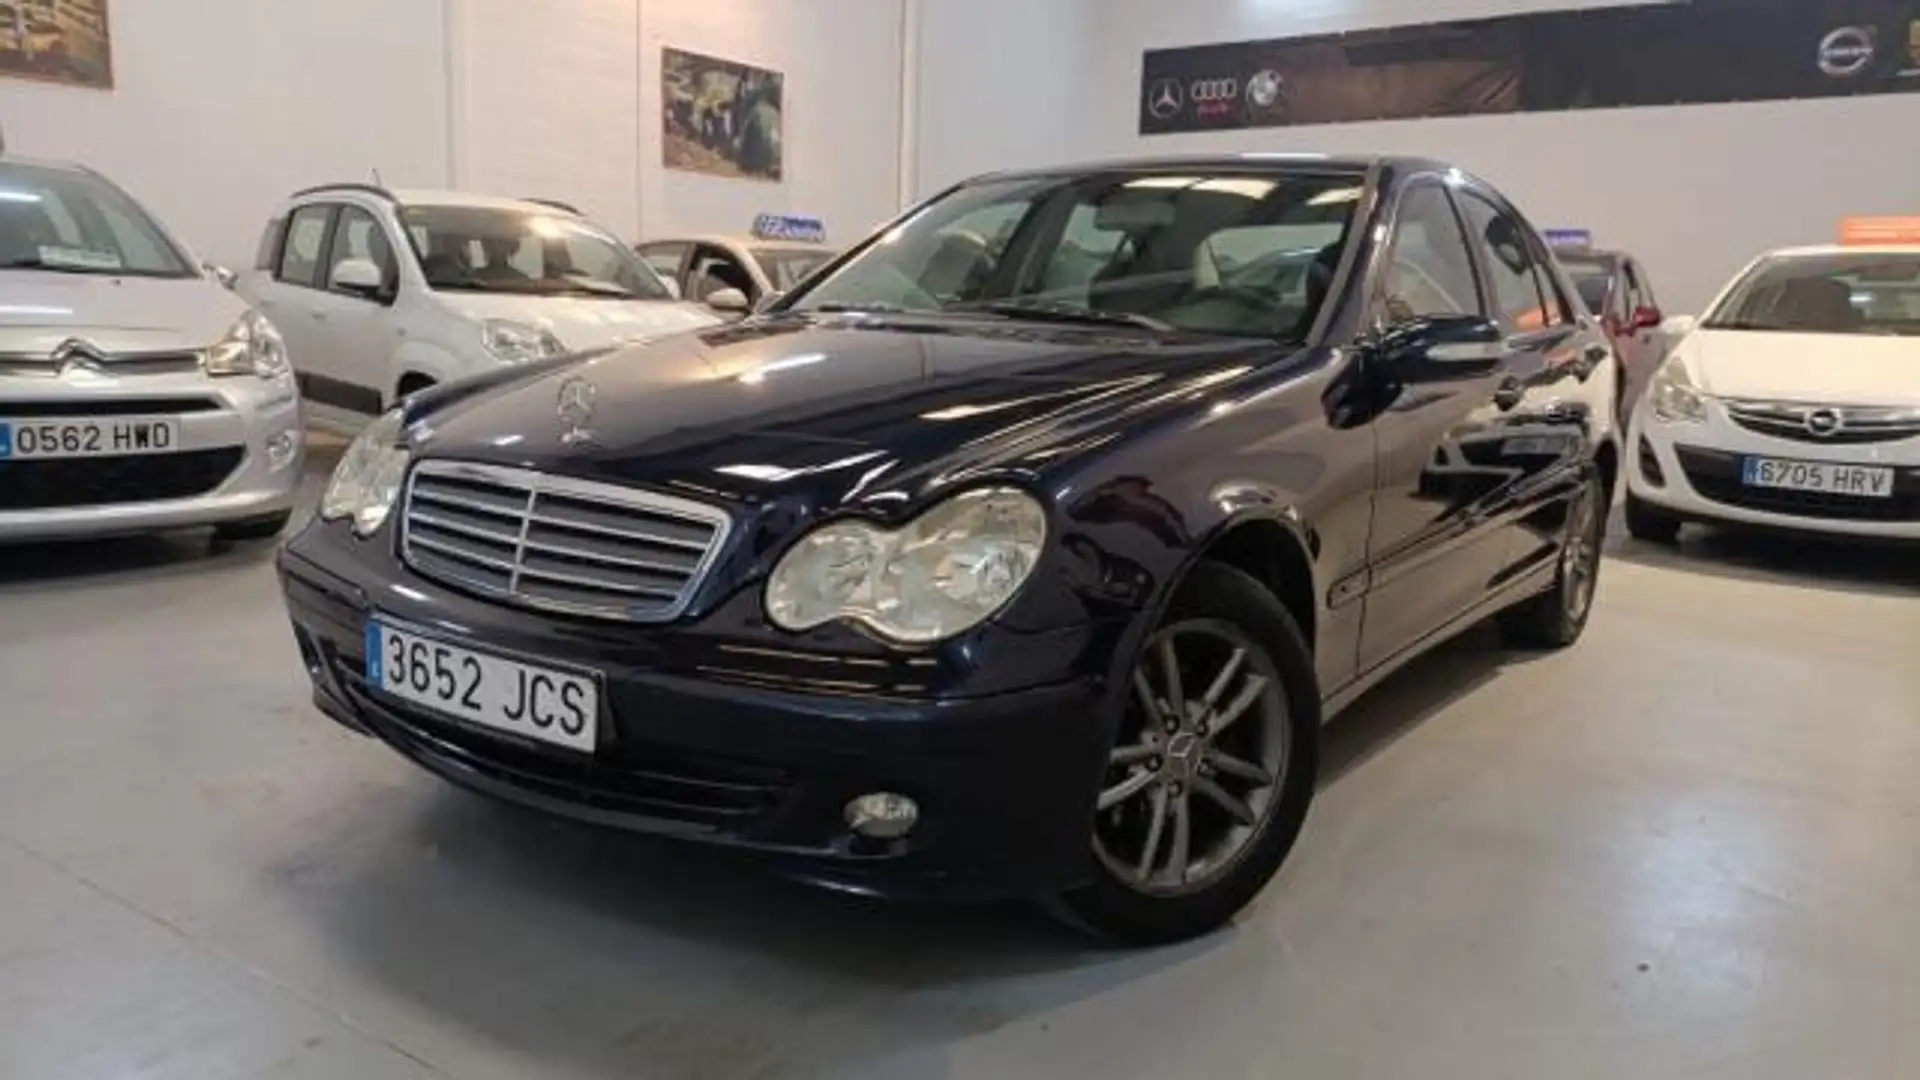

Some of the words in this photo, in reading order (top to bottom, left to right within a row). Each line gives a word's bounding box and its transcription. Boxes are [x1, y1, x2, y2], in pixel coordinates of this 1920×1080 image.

[17, 425, 101, 454] 0562
[113, 422, 170, 450] HWD
[1761, 461, 1823, 487] 6705
[1833, 466, 1885, 493] HRV
[389, 633, 482, 711] 3652
[503, 669, 585, 735] JCS
